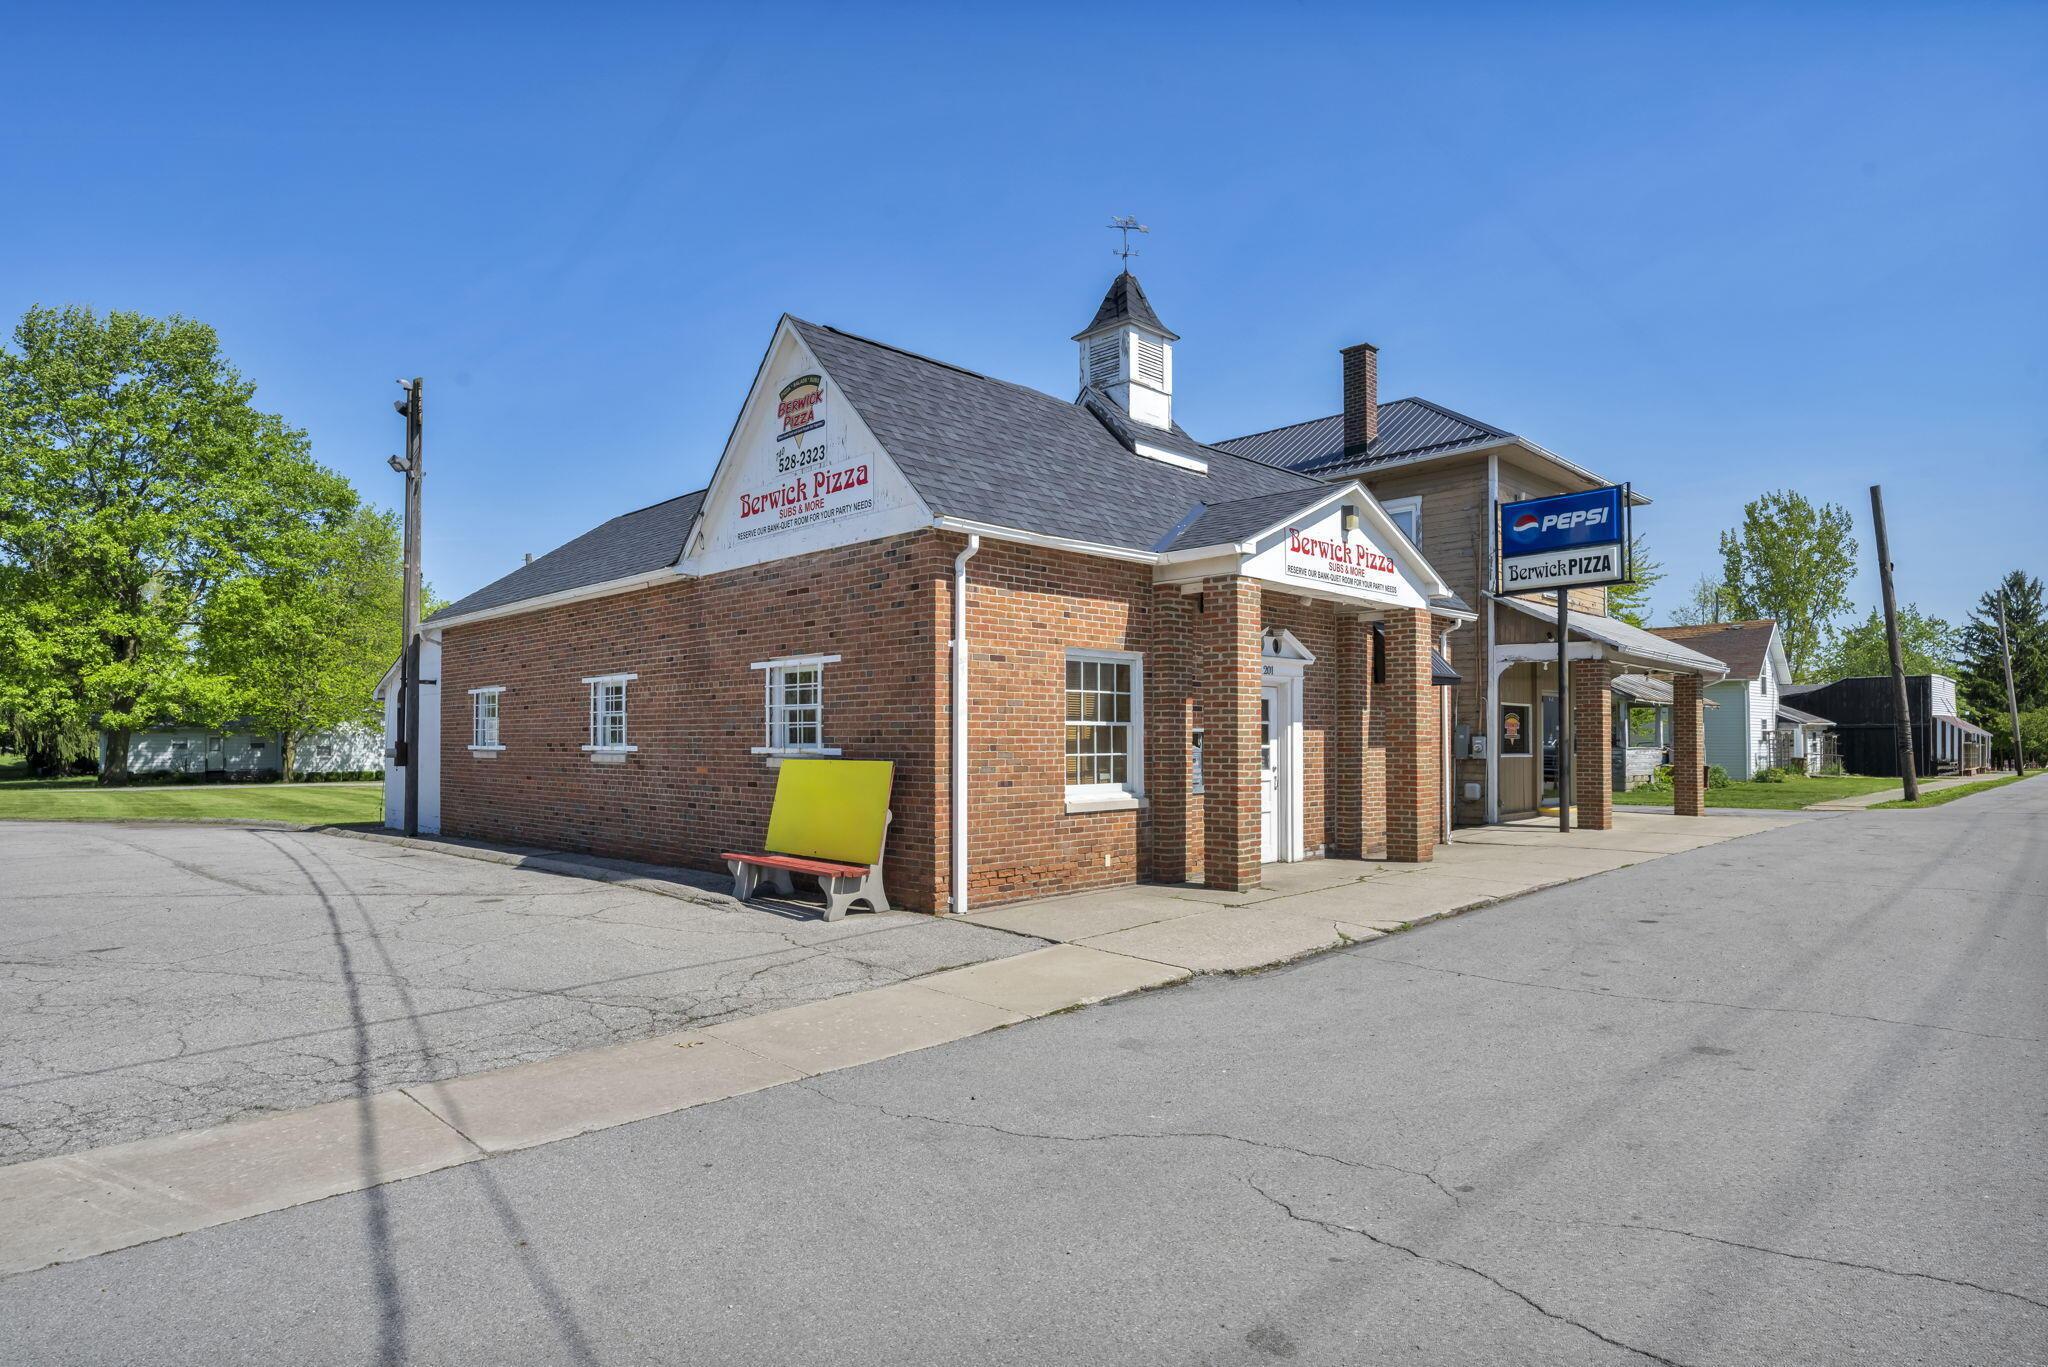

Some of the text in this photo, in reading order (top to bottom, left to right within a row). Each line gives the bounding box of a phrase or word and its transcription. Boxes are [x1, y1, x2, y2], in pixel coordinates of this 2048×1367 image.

[777, 388, 824, 419] BERWICK
[783, 409, 815, 431] PIZZA
[778, 445, 826, 472] 528-2323
[740, 464, 869, 518] Berwick Pizza
[737, 528, 757, 540] RESERVE
[757, 526, 767, 536] OUR
[794, 515, 809, 526] ROOM
[809, 512, 820, 522] FOR
[820, 508, 835, 519] YOUR
[835, 503, 853, 516] PARTY
[853, 499, 873, 511] NEEDS
[779, 498, 825, 519] SUBS & MORE
[1541, 507, 1609, 532] PEPSI
[1289, 527, 1395, 574] Berwick Pizza
[1287, 564, 1308, 576] RESERVE
[1307, 569, 1318, 578] OUR
[1384, 584, 1398, 594] NEEDS
[1328, 561, 1344, 574] SUBS
[1350, 566, 1365, 578] MORE
[1508, 555, 1611, 582] Berwick PIZZA
[1263, 665, 1273, 675] 201
